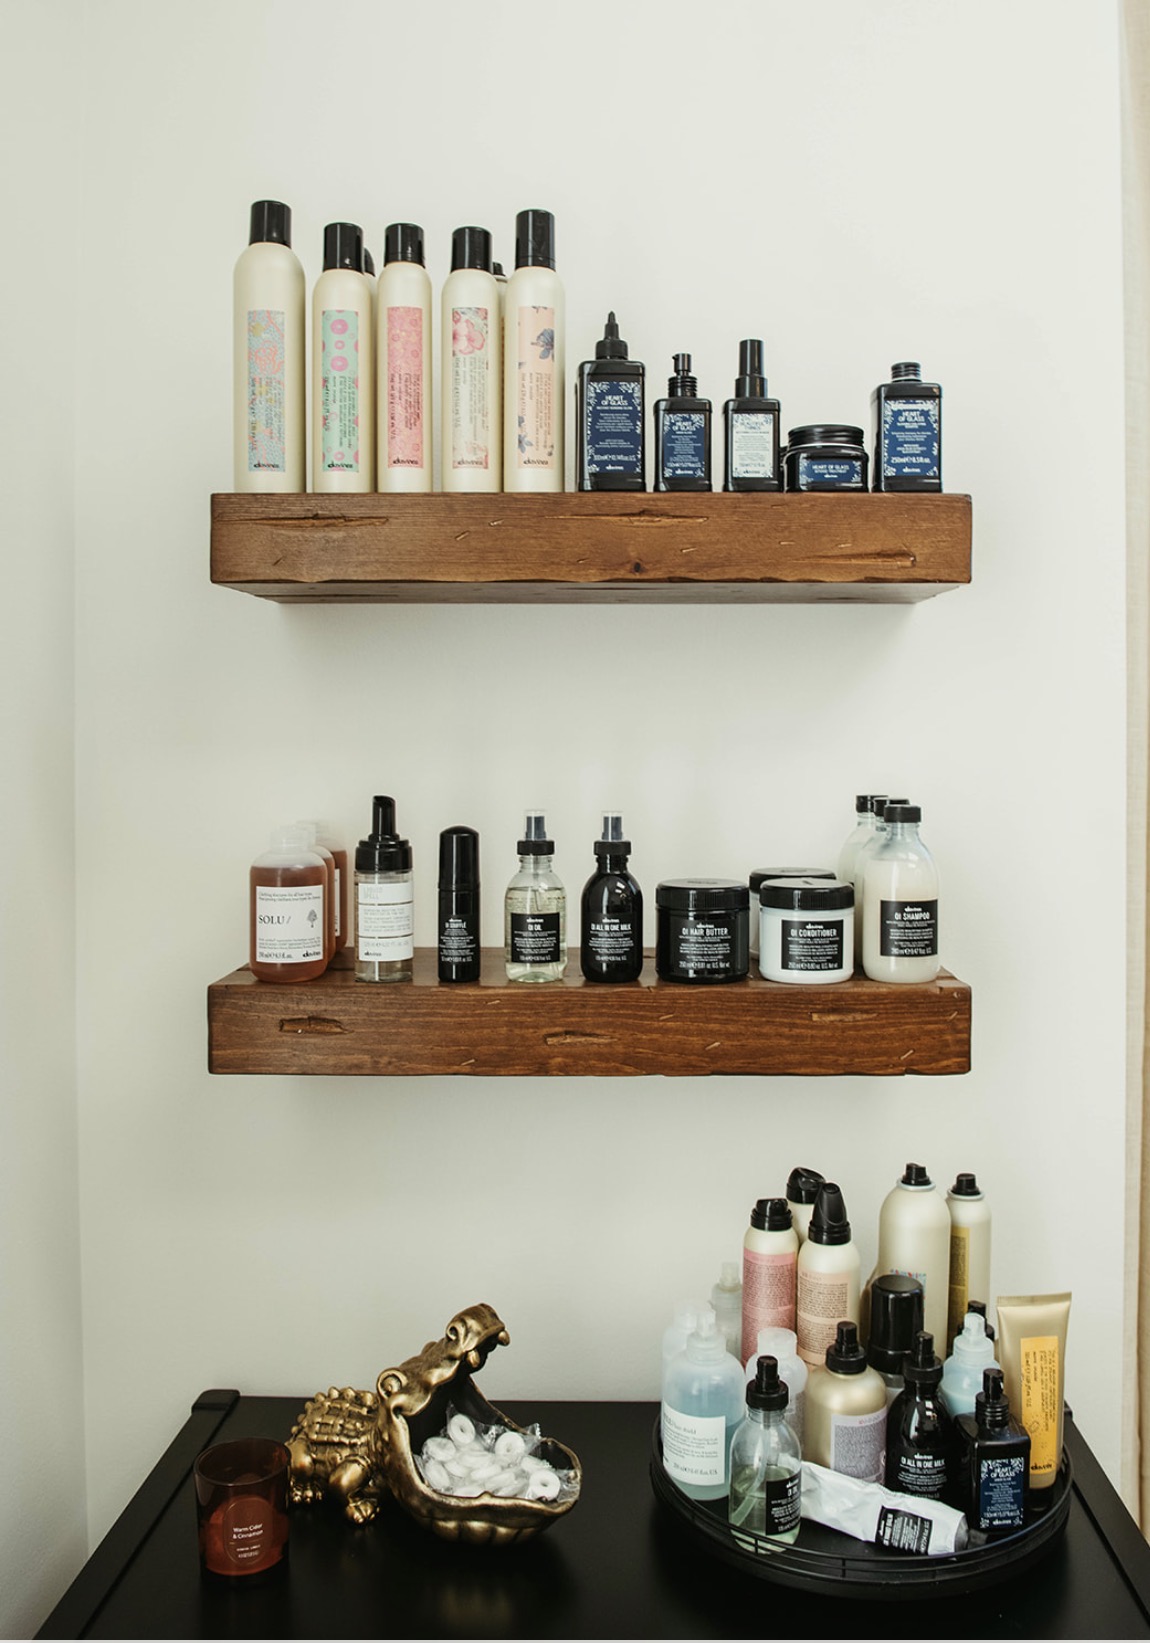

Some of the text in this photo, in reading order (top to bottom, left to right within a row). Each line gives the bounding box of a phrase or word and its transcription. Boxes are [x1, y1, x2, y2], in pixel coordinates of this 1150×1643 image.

[254, 460, 280, 469] davines
[328, 460, 354, 469] davines
[523, 456, 548, 466] davines
[258, 915, 285, 925] SOLU
[894, 912, 930, 920] OI SHAMPOO
[690, 928, 705, 936] HAIR
[706, 928, 728, 936] BUTTER
[790, 929, 837, 937] OI CONDITIONER
[907, 1458, 916, 1467] ALL
[923, 1460, 933, 1468] ONE
[934, 1459, 945, 1467] MILK
